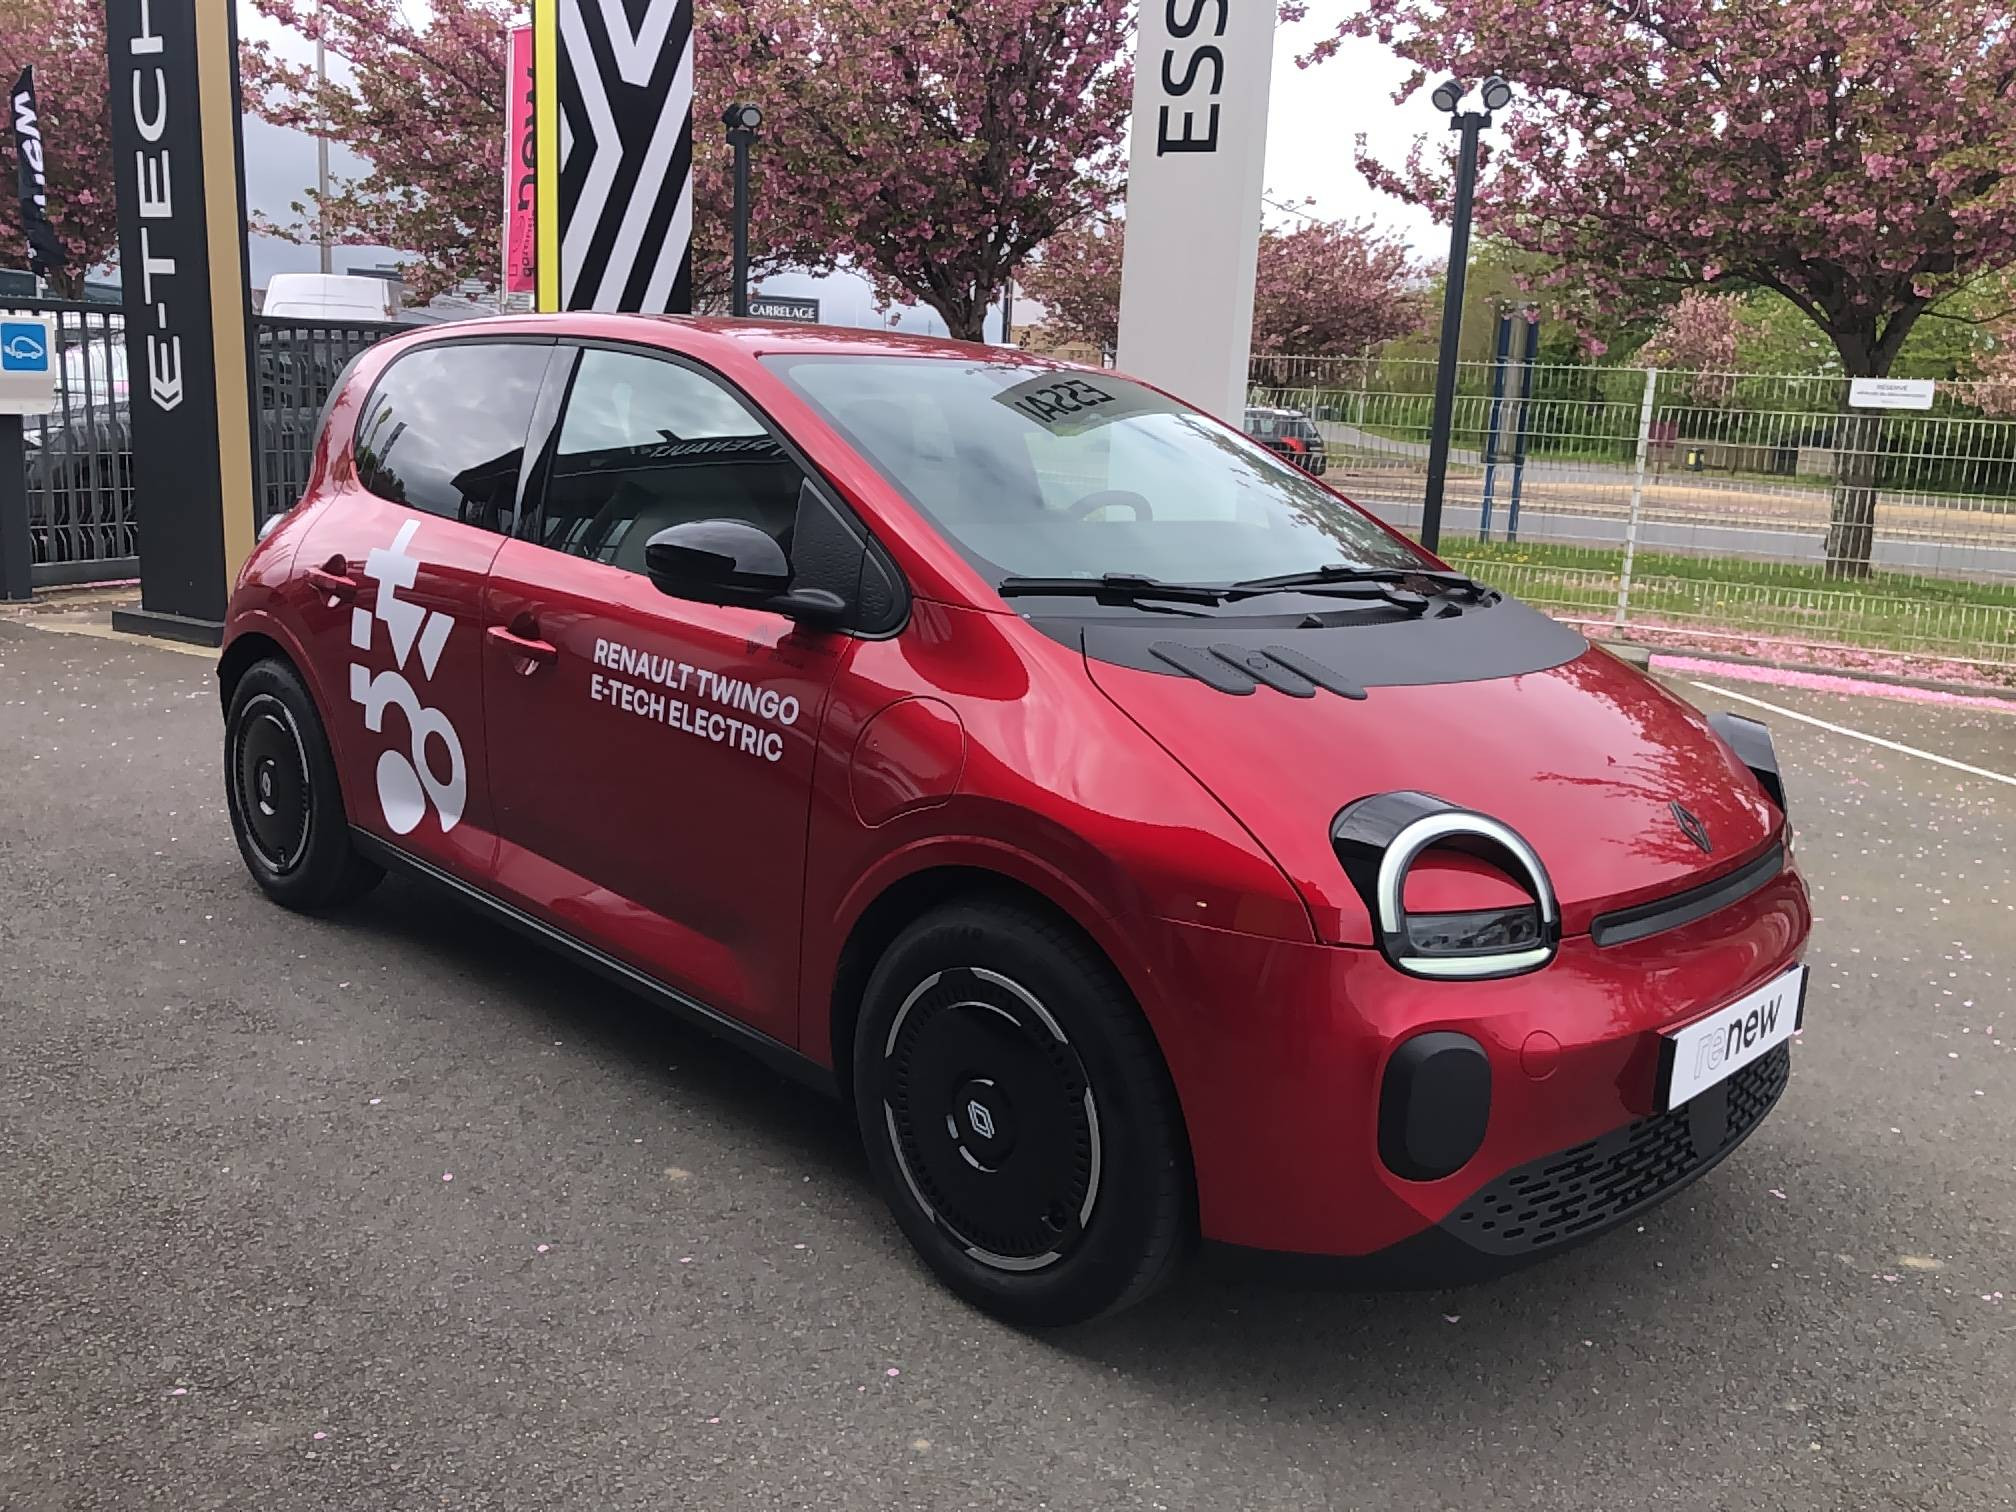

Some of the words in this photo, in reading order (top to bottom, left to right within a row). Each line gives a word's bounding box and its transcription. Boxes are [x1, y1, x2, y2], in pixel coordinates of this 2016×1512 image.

[749, 303, 816, 319] CARRELAGE
[591, 673, 665, 722] E-TECH
[668, 699, 783, 761] ELECTRIC
[593, 637, 695, 691] RENAULT
[696, 669, 800, 725] TWINGO
[1693, 993, 1783, 1081] renew
